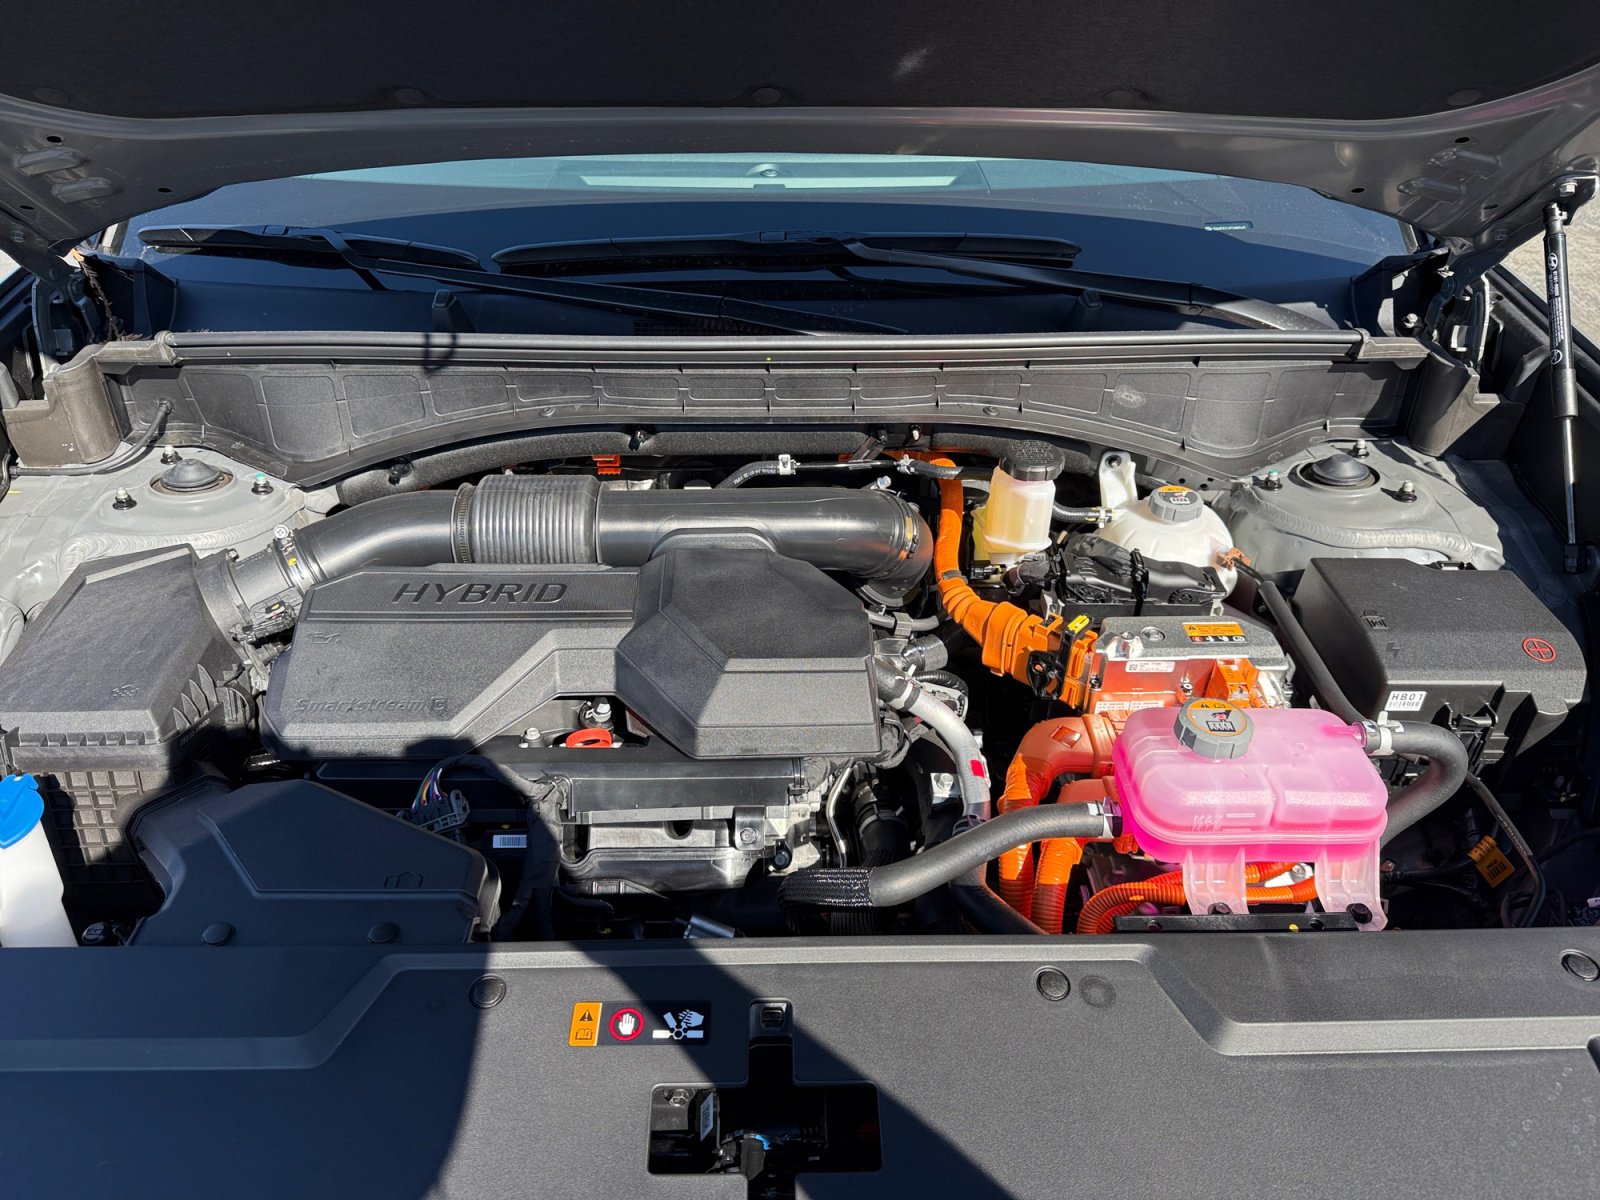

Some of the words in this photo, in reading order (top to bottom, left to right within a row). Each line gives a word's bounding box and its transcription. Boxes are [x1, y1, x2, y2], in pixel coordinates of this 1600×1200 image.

[392, 583, 568, 604] HYBRID
[294, 697, 426, 714] Smartstream
[1391, 693, 1424, 701] HB01
